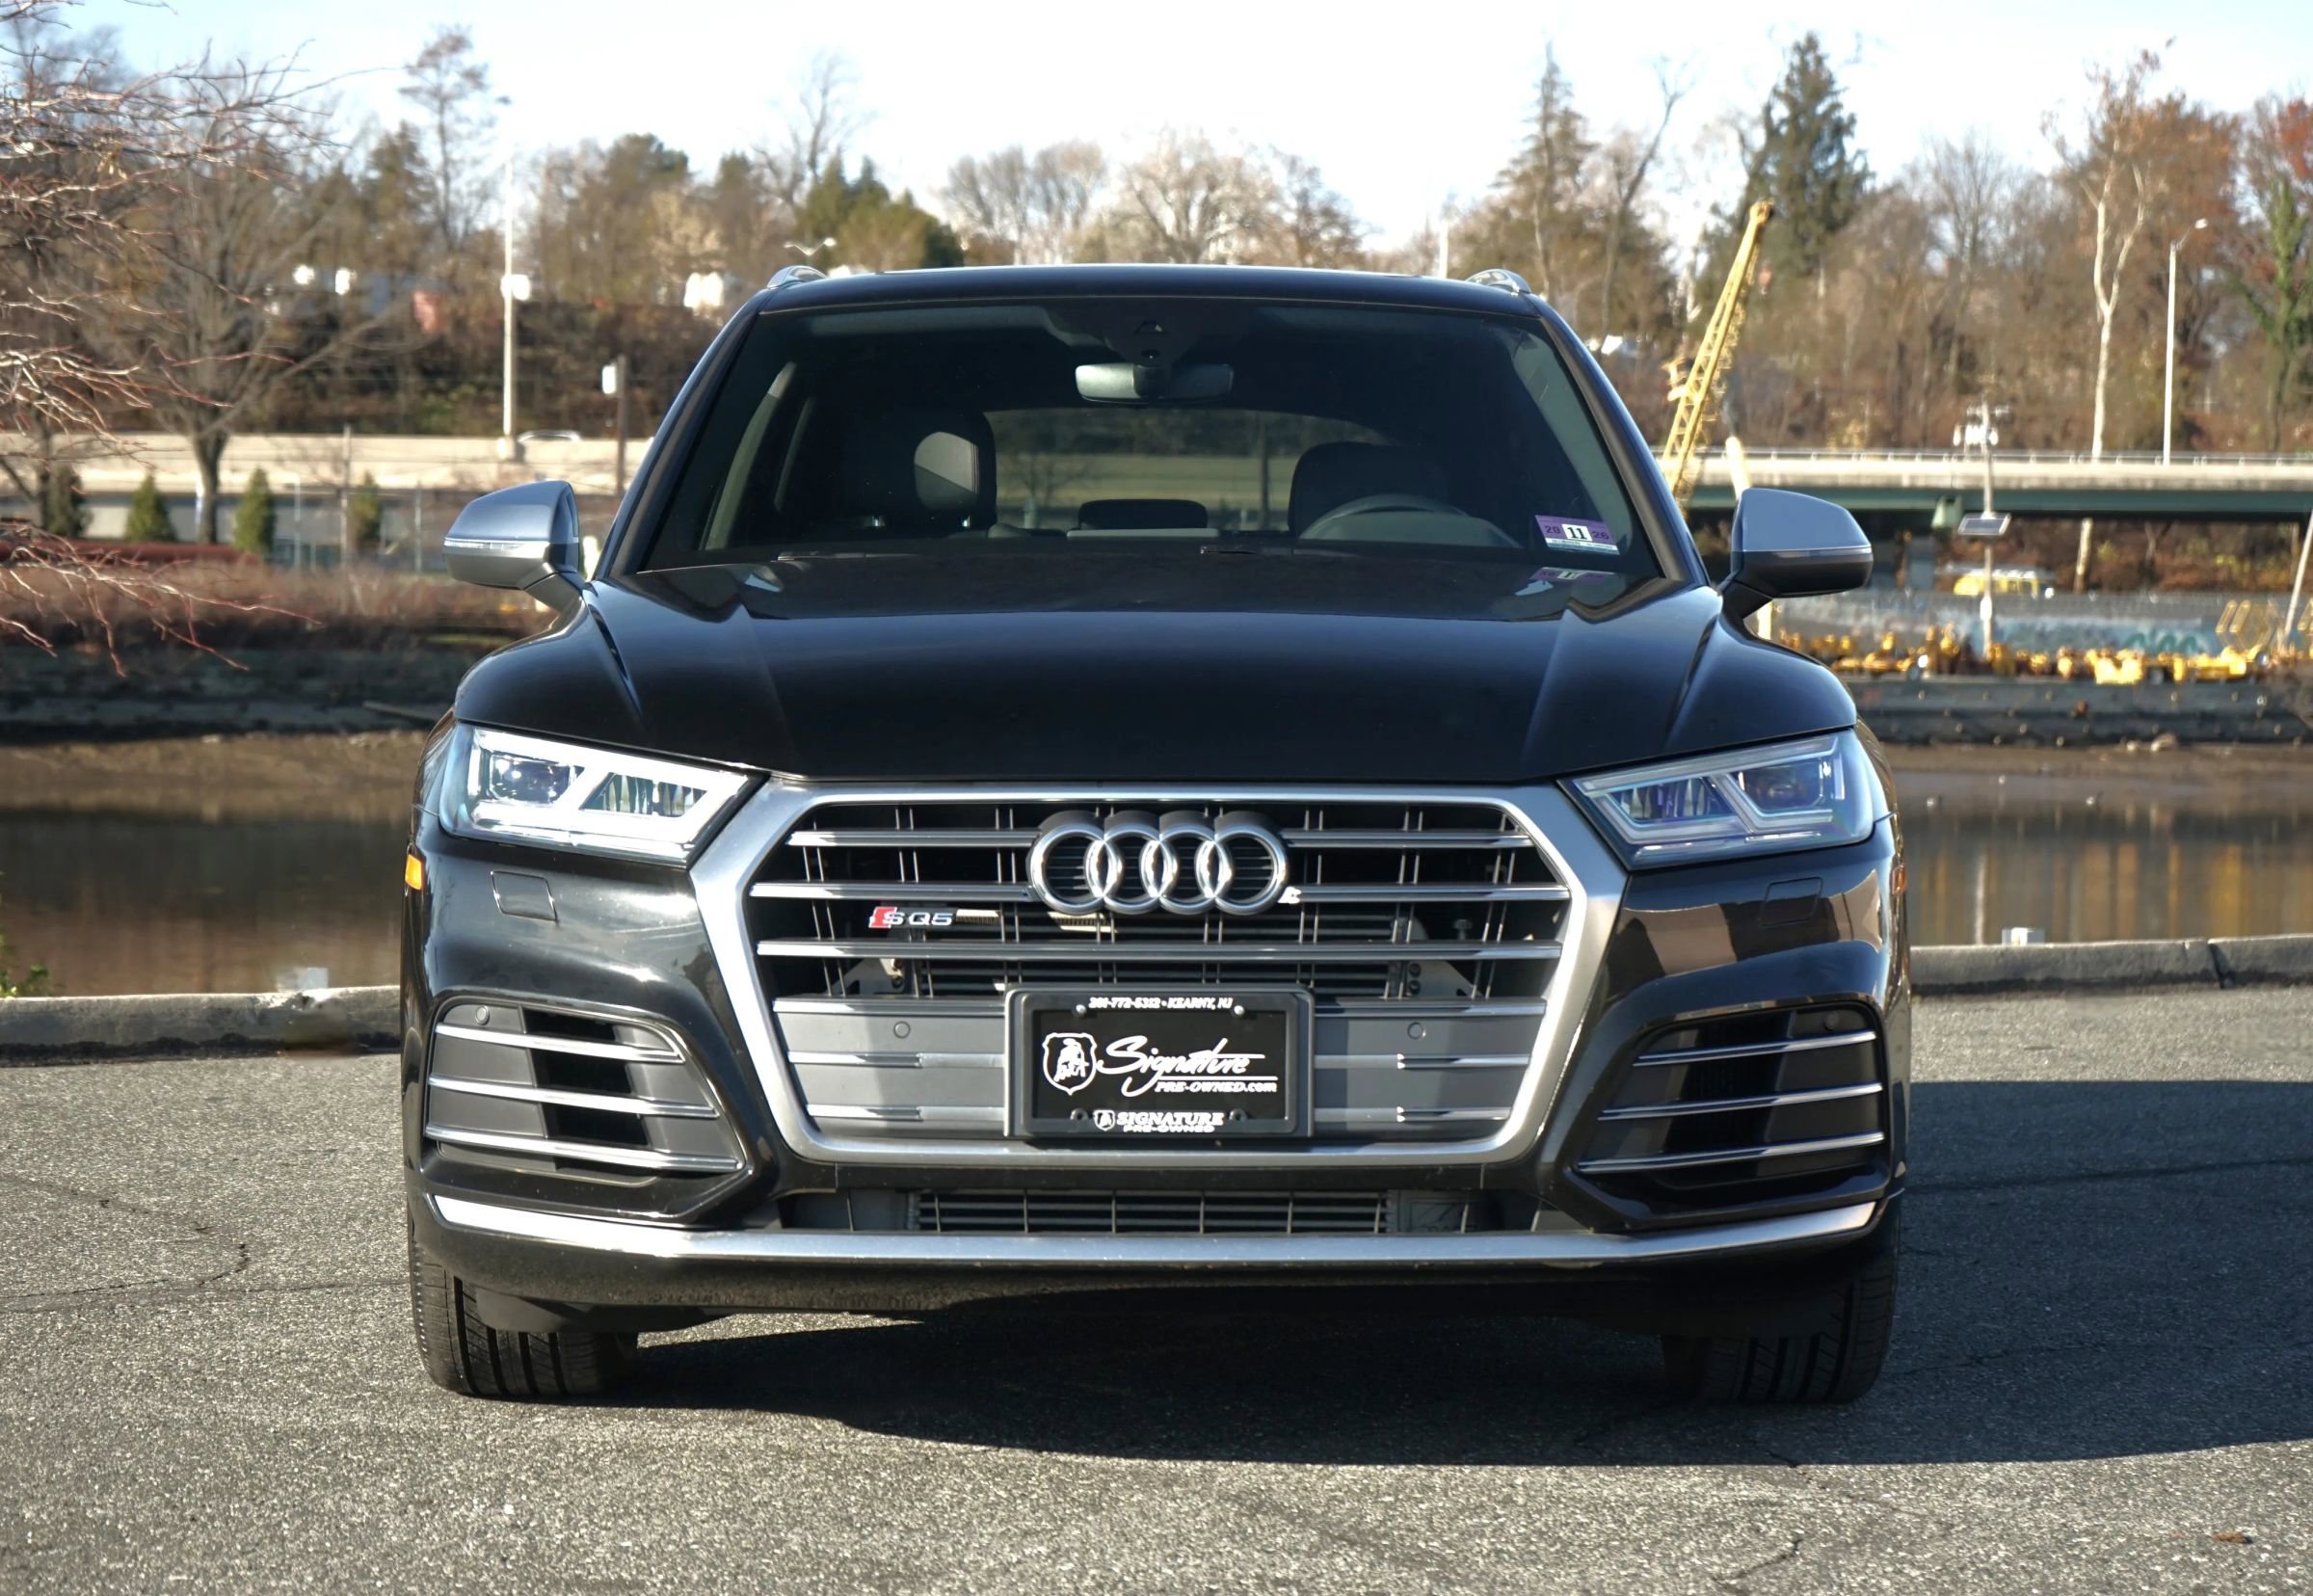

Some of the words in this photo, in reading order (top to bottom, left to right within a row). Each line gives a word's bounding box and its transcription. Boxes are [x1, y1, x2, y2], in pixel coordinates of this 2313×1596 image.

[1545, 525, 1560, 534] 20
[1567, 527, 1587, 539] 11
[882, 912, 953, 926] SQ5
[1216, 997, 1234, 1009] NJ
[1097, 1035, 1266, 1098] Signature
[1154, 1080, 1279, 1093] PRE-OWNED.com
[1116, 1111, 1226, 1126] SIGNATURE
[1123, 1125, 1215, 1133] PRE-OWNED
